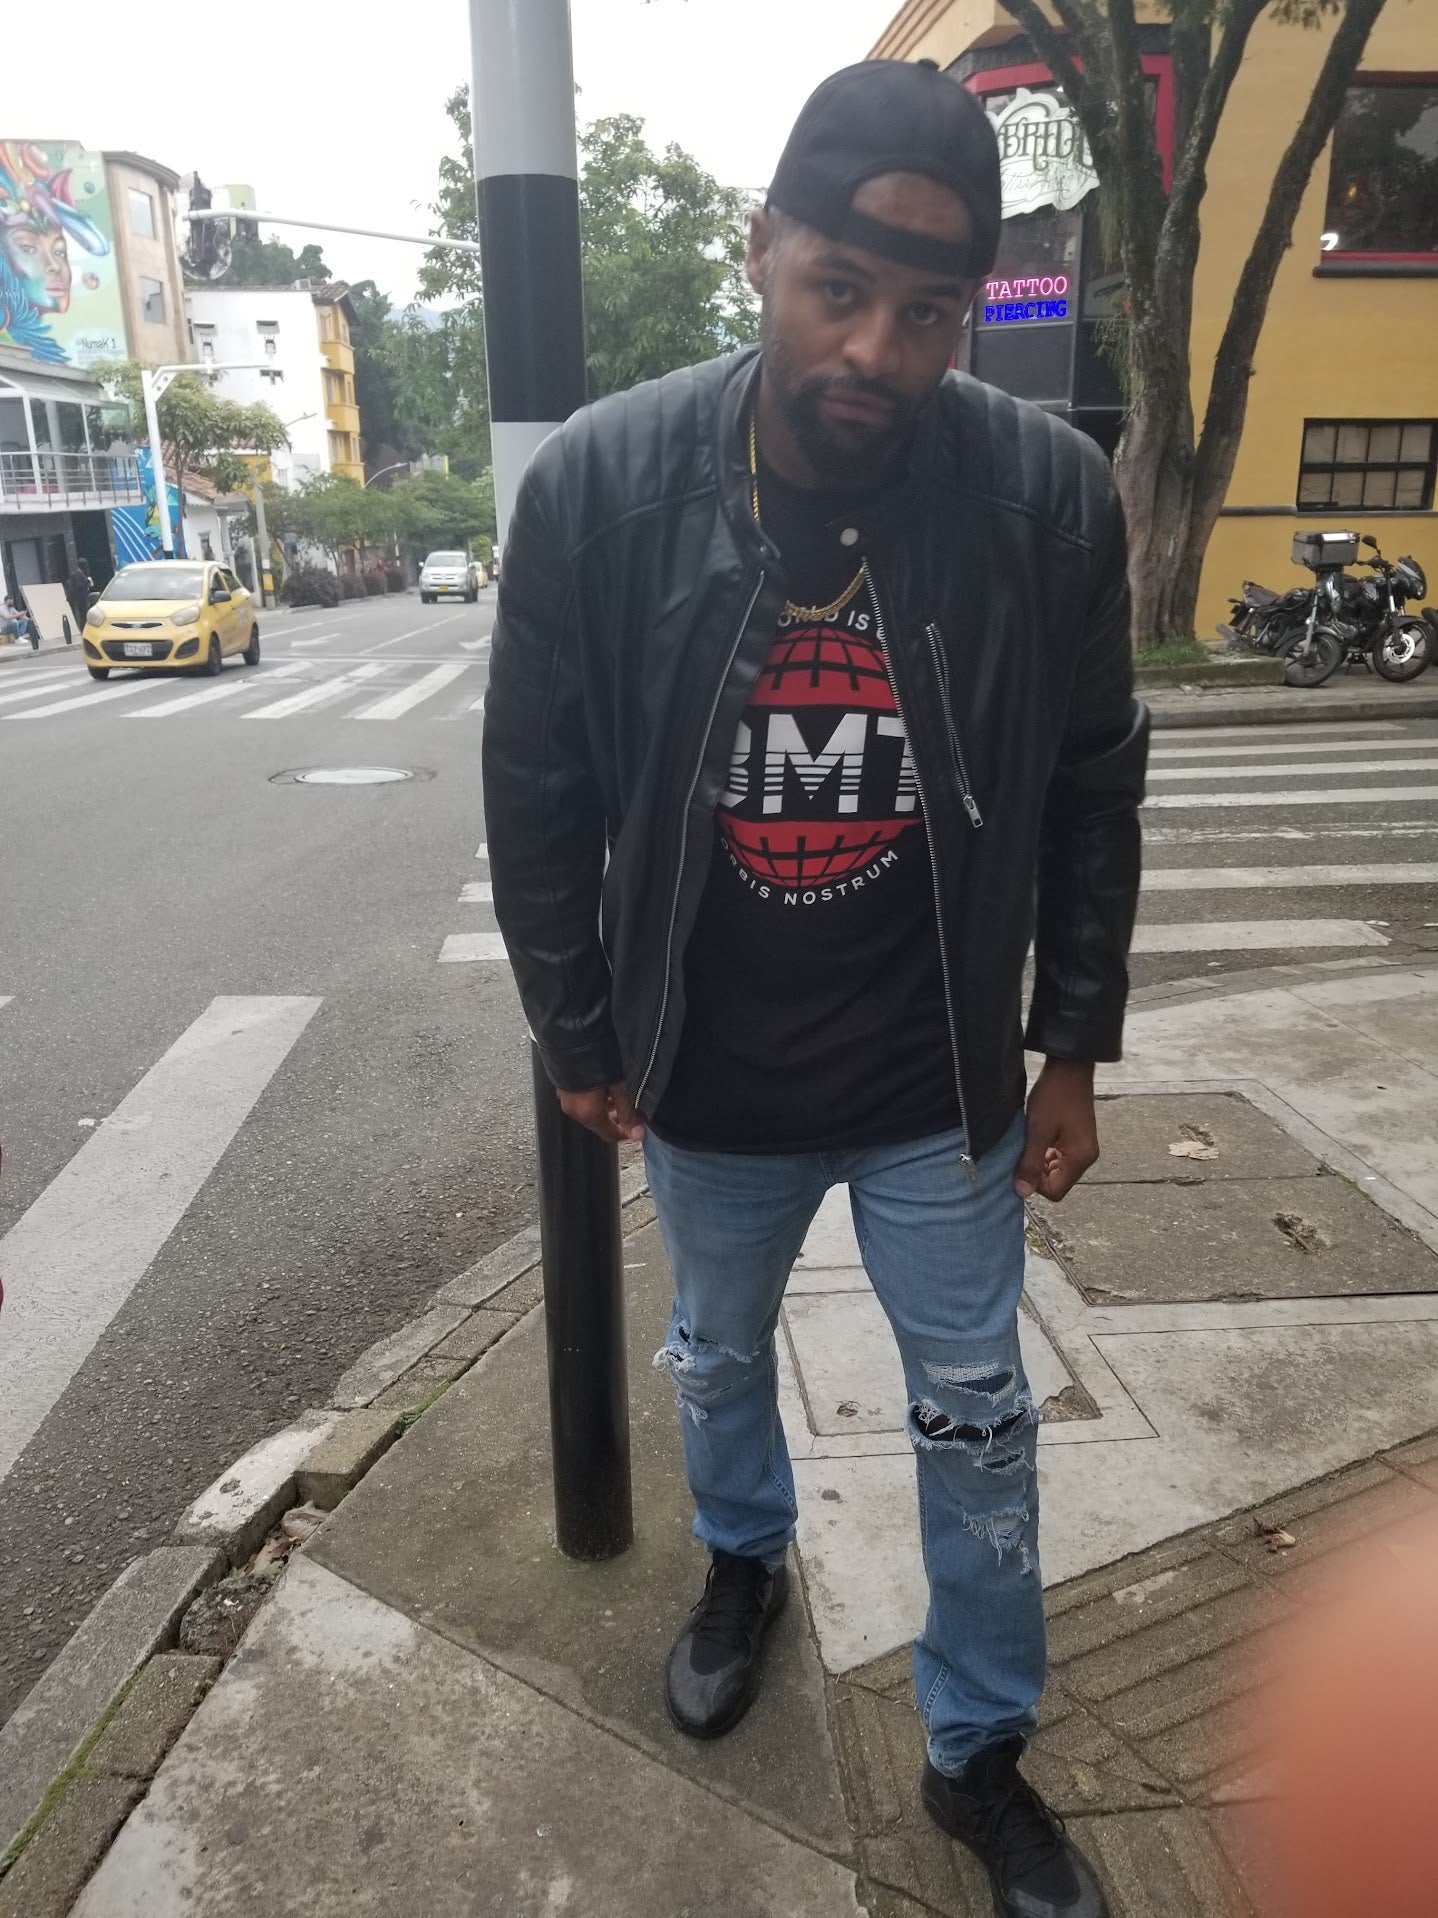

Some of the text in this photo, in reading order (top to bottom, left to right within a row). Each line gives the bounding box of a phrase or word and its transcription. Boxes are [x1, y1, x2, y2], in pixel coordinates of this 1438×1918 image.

[986, 276, 1068, 300] TATTOO
[984, 300, 1067, 323] PIERCING
[847, 609, 871, 631] IS
[720, 837, 899, 905] ORBIS NOSTRUM
